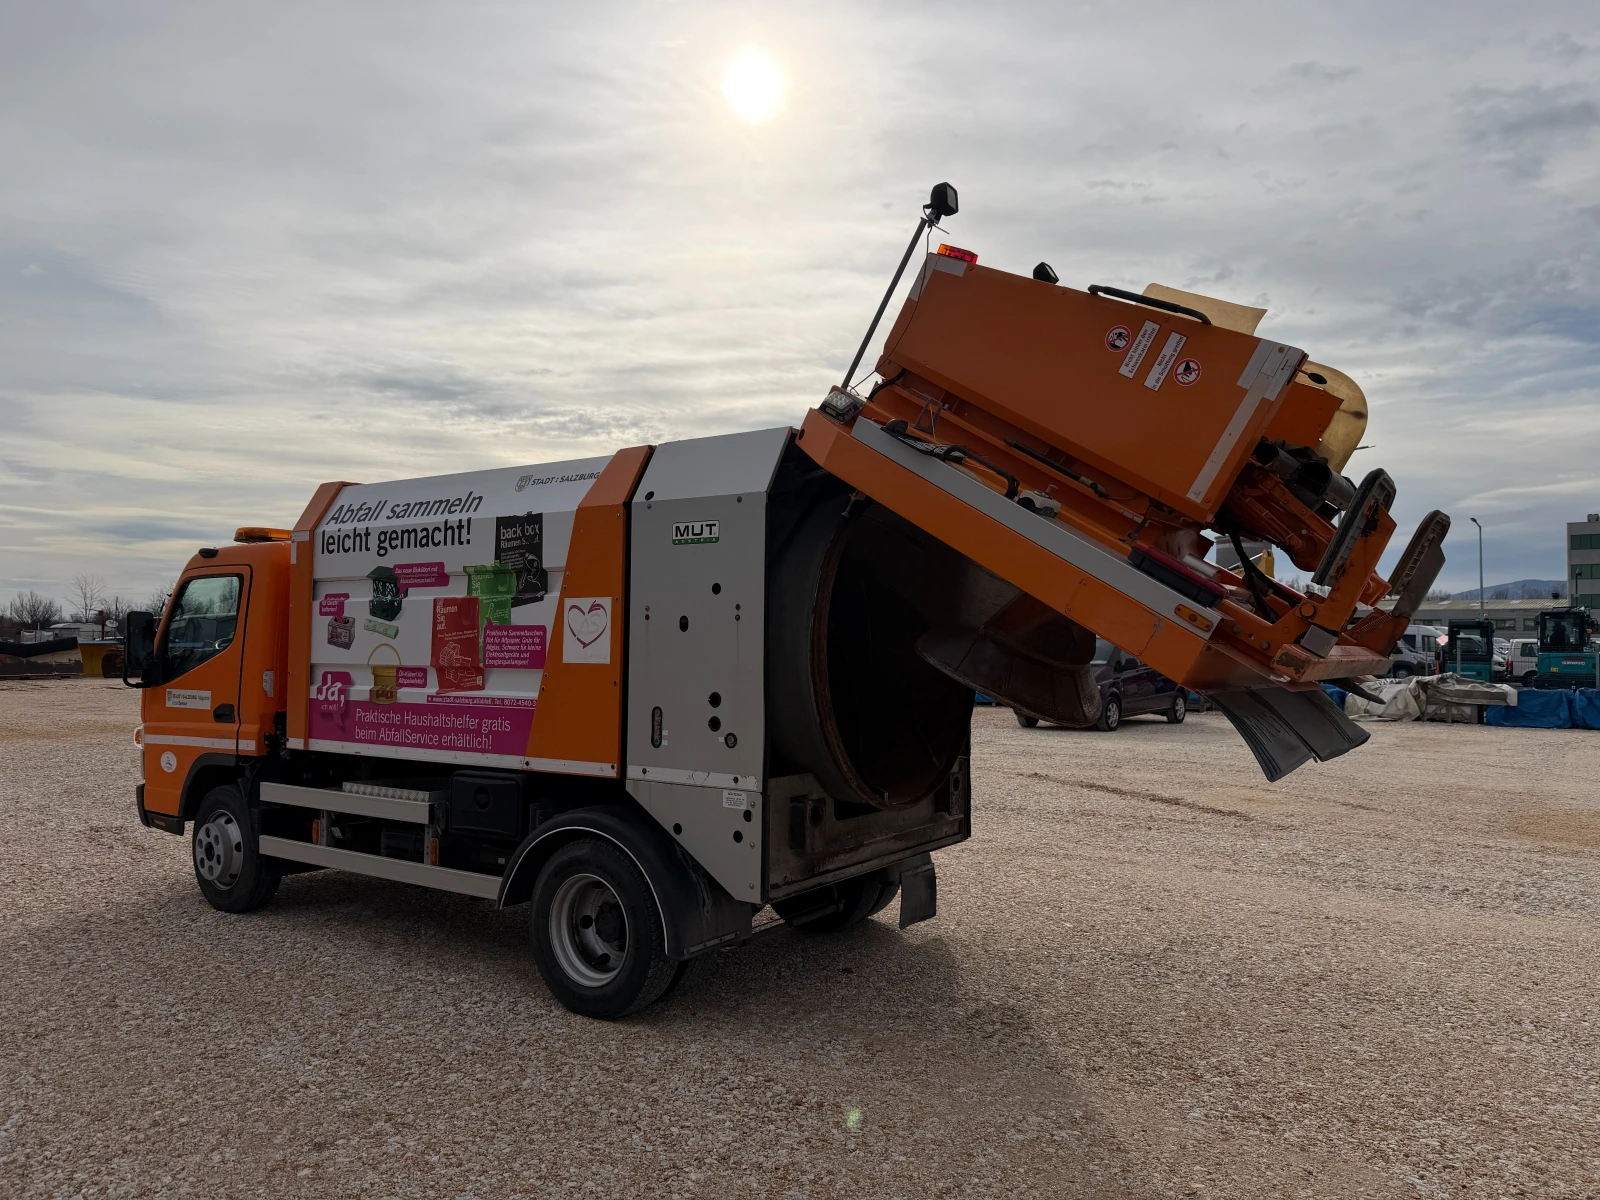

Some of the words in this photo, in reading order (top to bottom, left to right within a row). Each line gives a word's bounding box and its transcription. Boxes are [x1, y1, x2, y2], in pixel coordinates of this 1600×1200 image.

[1124, 354, 1134, 367] Nicht
[1132, 339, 1143, 354] hinter
[1156, 354, 1167, 366] Nicht
[531, 476, 555, 486] STADT
[559, 472, 600, 483] SALZBURG
[325, 500, 388, 525] Abfall
[386, 491, 483, 520] sammeln
[321, 527, 371, 554] leicht
[377, 517, 472, 557] gemacht!
[500, 524, 522, 540] back
[525, 522, 540, 535] box
[675, 523, 716, 537] MUT
[436, 605, 458, 614] Räumen
[436, 614, 445, 622] Sie
[436, 621, 447, 630] auf.
[316, 673, 344, 707] Ja,
[356, 708, 401, 724] Praktische
[404, 711, 479, 729] Haushaltshelfer
[482, 716, 511, 733] gratis
[355, 726, 376, 740] beim
[379, 727, 439, 745] AbfallService
[441, 733, 492, 749] erhältlich!
